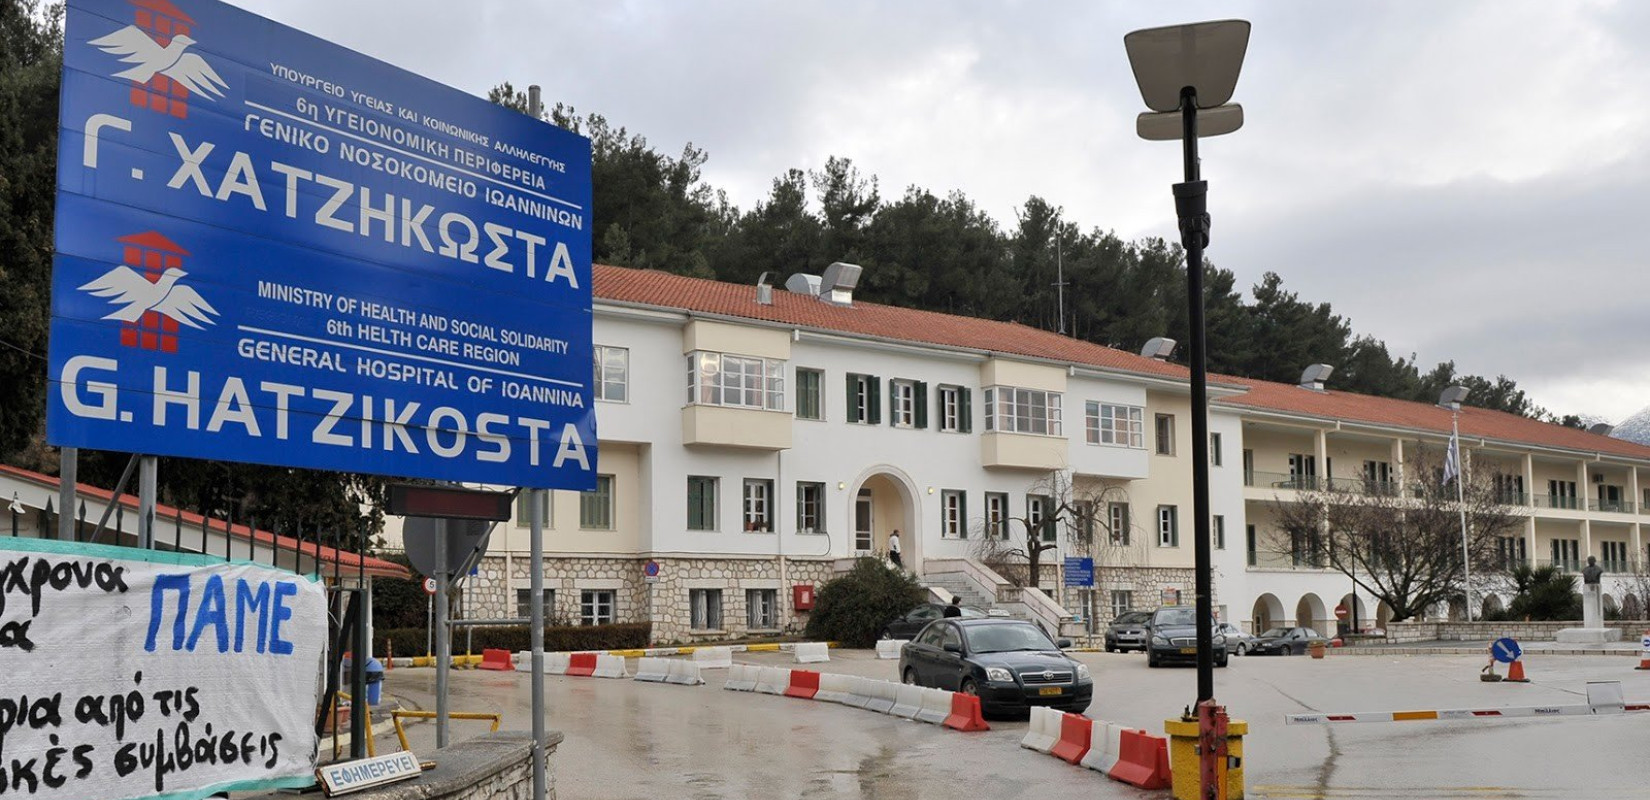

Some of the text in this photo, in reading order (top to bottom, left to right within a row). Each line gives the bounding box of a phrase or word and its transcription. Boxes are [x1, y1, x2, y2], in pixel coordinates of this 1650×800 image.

[269, 62, 566, 174] ΥΠΟΥΡΓΕΙΟ ΥΓΕΙΑΣ ΚΑΙ ΚΟΙΝΩΝΙΚΗΣ ΑΛΛΗΛΕΓΓΥΗΣ
[296, 97, 546, 190] 6η ΥΓΕΙΟΝΟΜΙΚΗ ΠΕΡΙΦΕΡΕΙΑ
[82, 113, 579, 289] Γ. ΧΑΤΖΗΚΩΣΤΑ
[244, 113, 583, 231] ΓΕΝΙΚΟ ΝΟΣΟΚΟΜΕΙΟ ΙΩΑΝΝΙΝΩΝ
[257, 280, 569, 355] MINISTRY OF HEALTH AND SOCIAL SOLIDARITY
[326, 319, 520, 367] 6th HELTH CARE REGION
[237, 338, 584, 409] GENERAL HOSPITAL OF IOANNINA
[60, 355, 591, 472] G. HATZIKOSTA
[144, 573, 297, 655] ΠΑΜΕ
[75, 670, 145, 741] από
[153, 686, 200, 723] τις
[114, 721, 283, 792] συμβάσεις
[330, 755, 416, 787] ΕΦΗΜΕΡΕΥΕΙ
